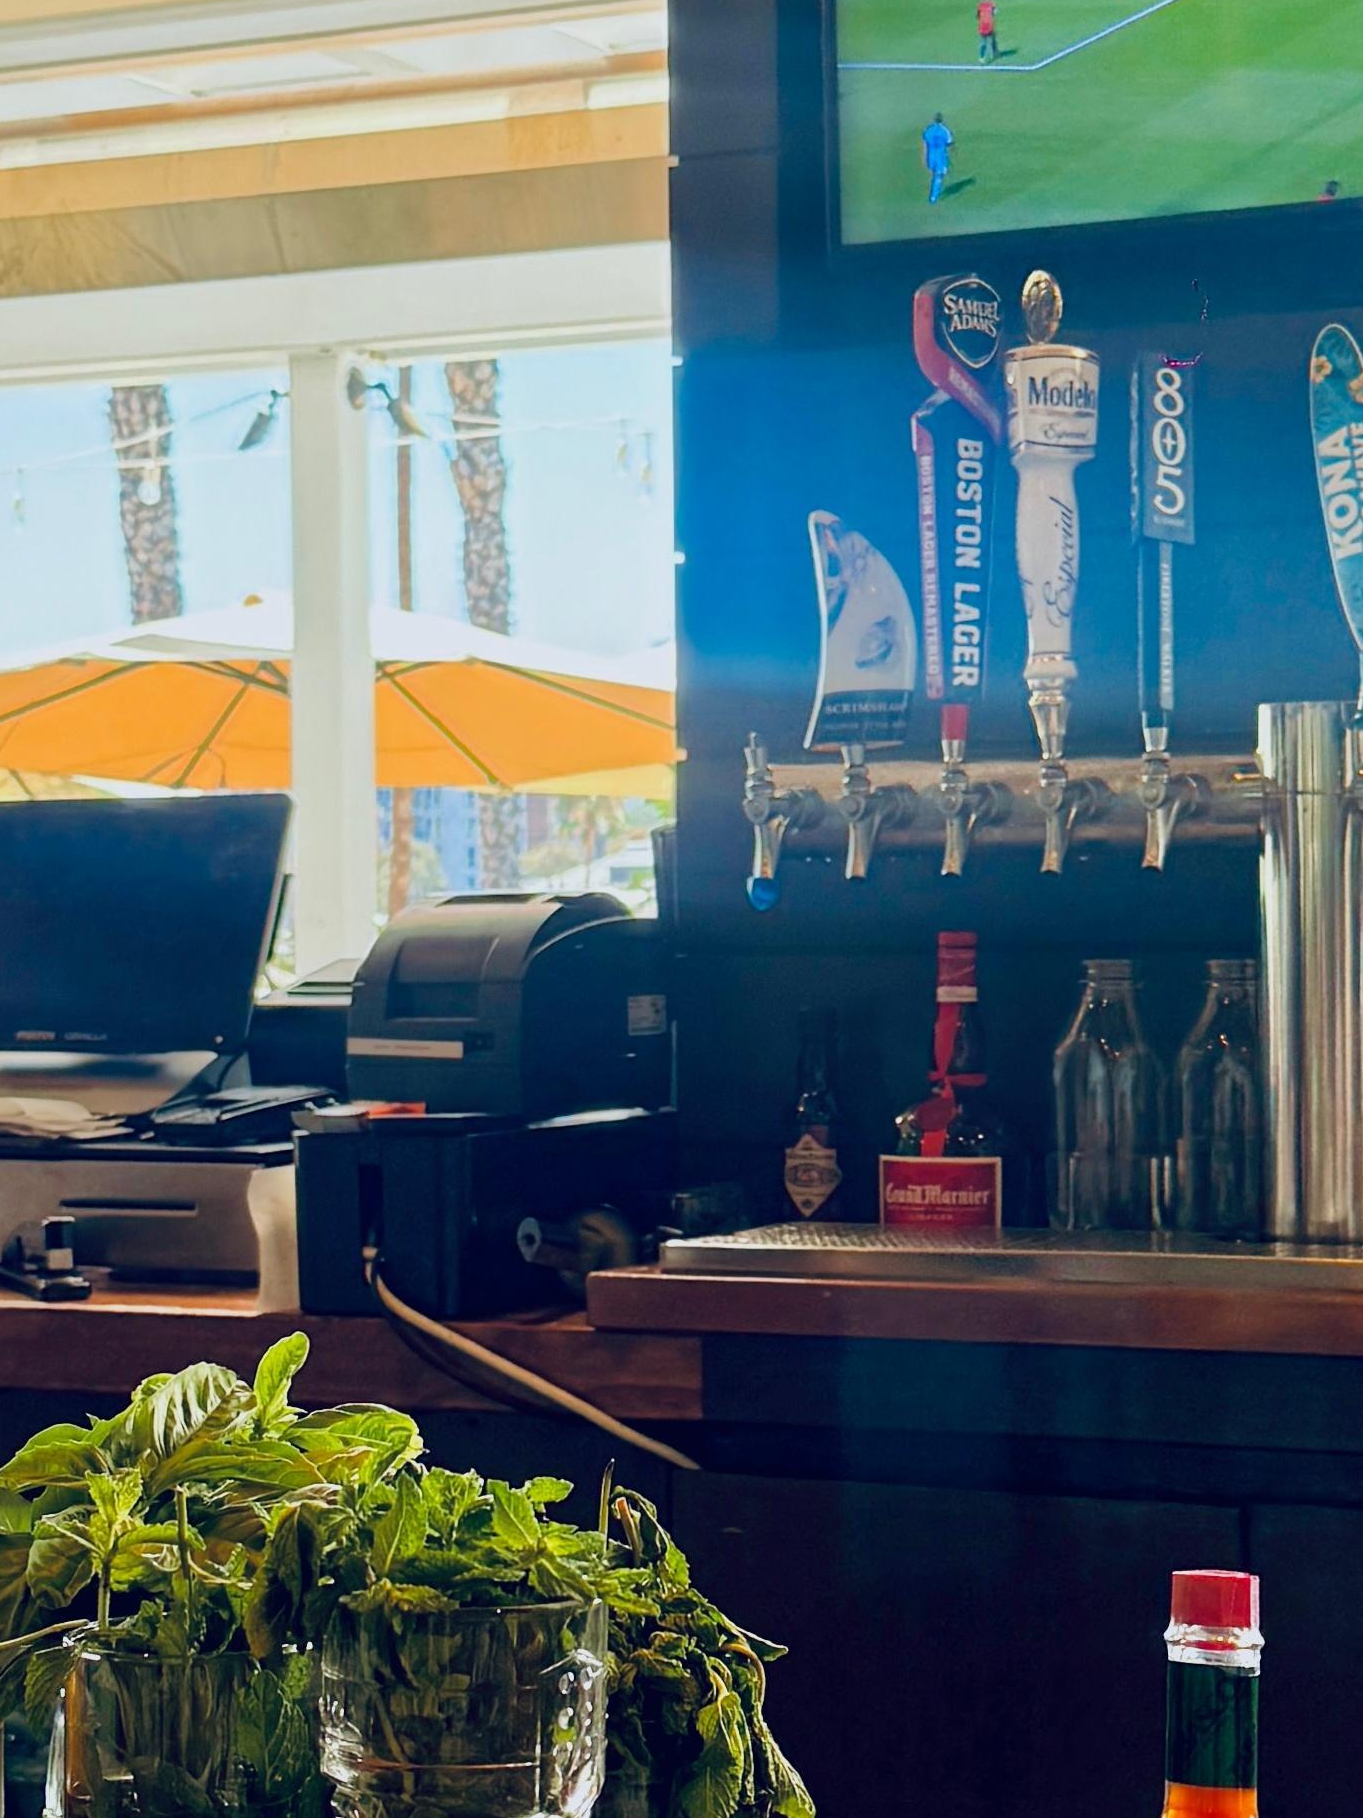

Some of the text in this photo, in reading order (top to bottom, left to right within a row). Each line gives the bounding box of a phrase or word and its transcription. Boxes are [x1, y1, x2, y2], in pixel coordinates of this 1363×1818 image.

[944, 294, 1000, 321] SAMUEL
[950, 315, 997, 337] ADAMS
[1152, 367, 1186, 515] 805
[920, 455, 933, 515] BOSTON
[1317, 426, 1363, 560] KONA
[921, 520, 935, 569] LAGER
[952, 438, 984, 686] BOSTON LAGER
[1043, 495, 1076, 628] Especial
[921, 1185, 990, 1206] Marnier
